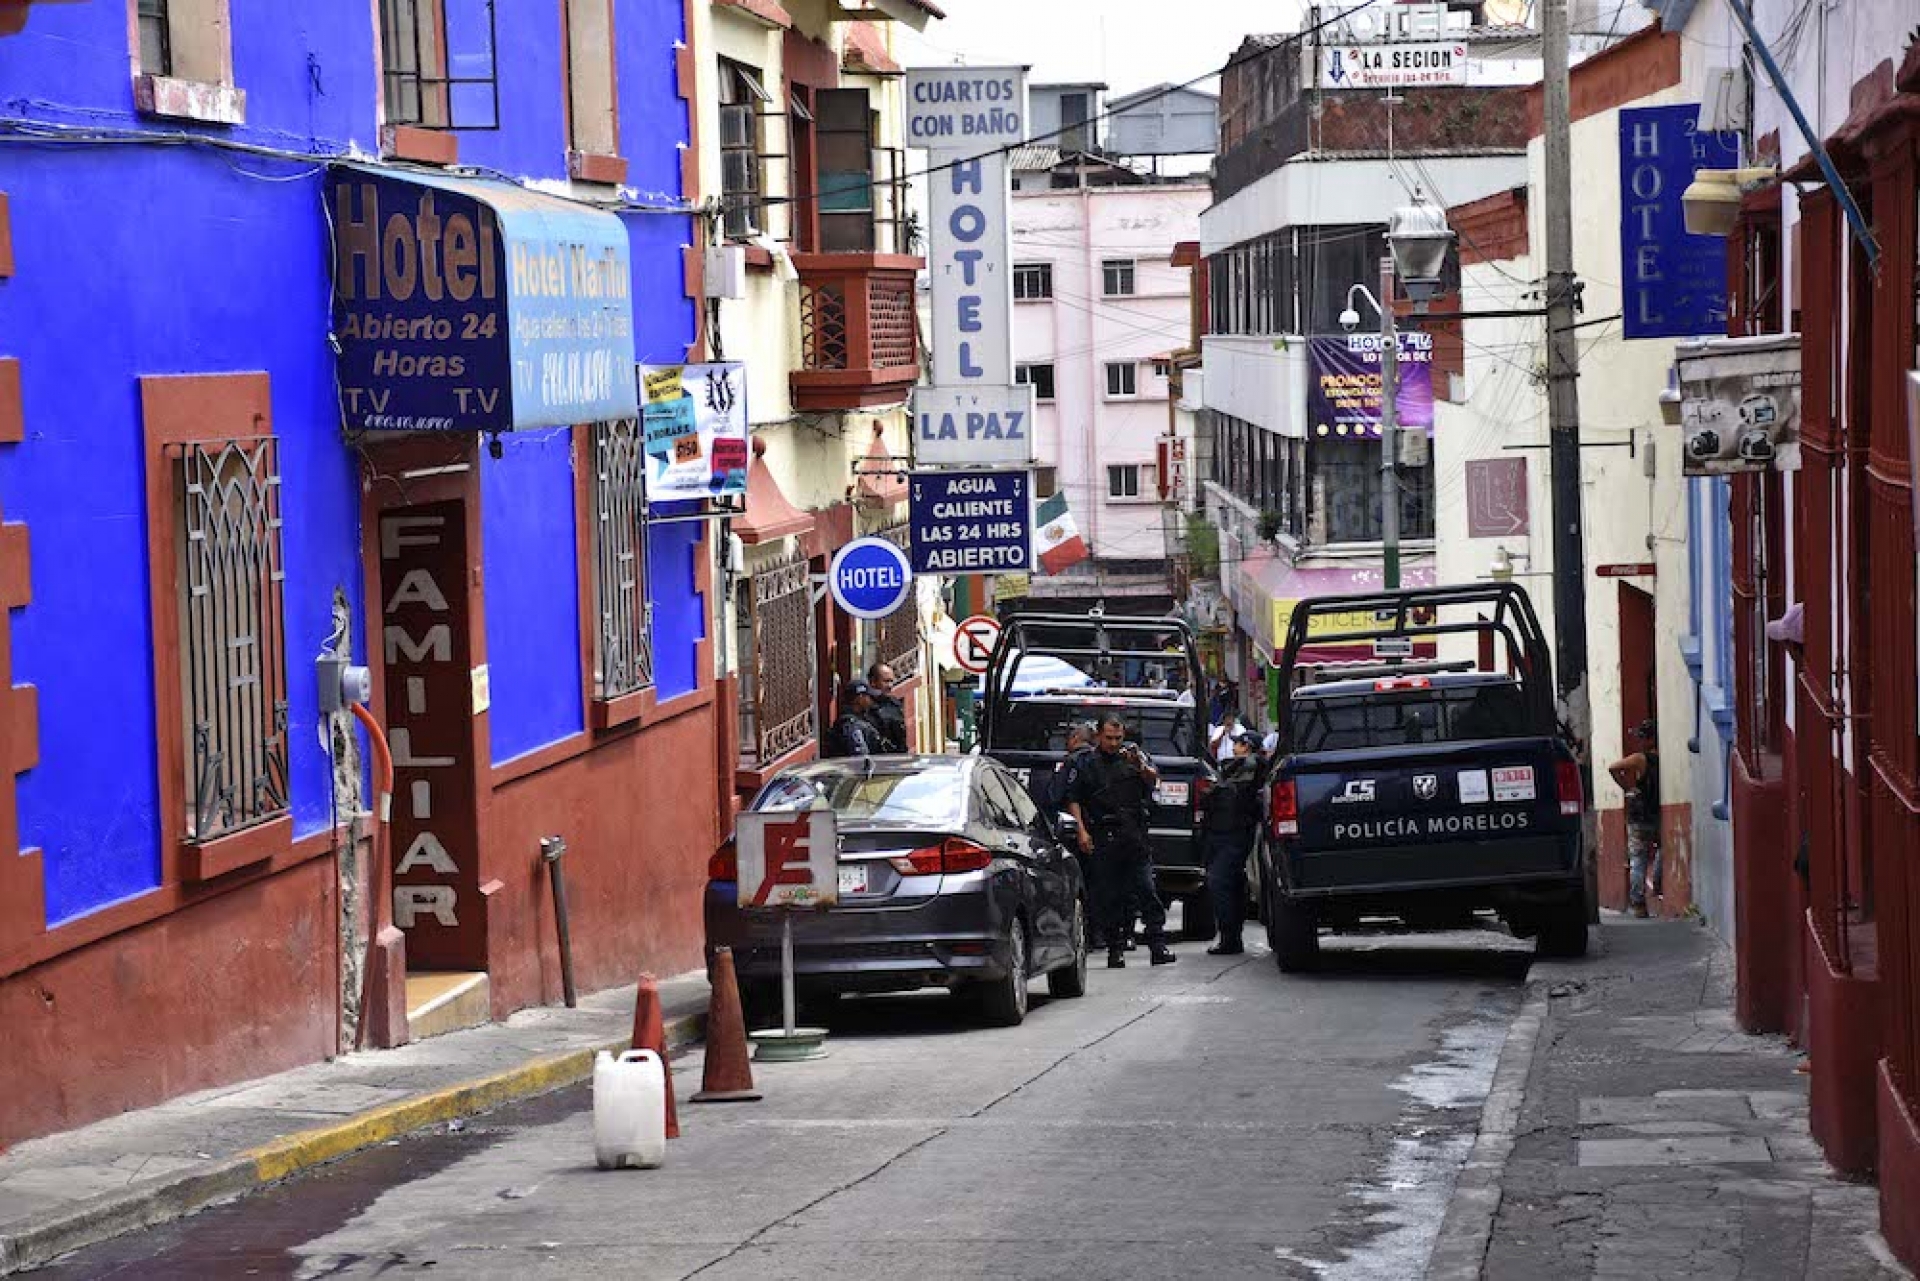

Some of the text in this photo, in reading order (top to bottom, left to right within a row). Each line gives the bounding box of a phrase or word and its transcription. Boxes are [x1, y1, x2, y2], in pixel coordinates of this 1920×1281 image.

[1363, 51, 1450, 68] LA SECION
[914, 80, 1013, 102] CUARTOS
[912, 108, 1019, 136] CON BAÑO
[1632, 122, 1663, 323] HOTEL
[336, 184, 496, 300] Hotel
[512, 243, 566, 297] Hotel
[950, 157, 986, 377] HOTEL
[342, 312, 497, 340] Abierto 24
[373, 350, 465, 377] Horas
[345, 388, 390, 414] T.V
[453, 388, 499, 414] T.V
[921, 413, 1024, 440] LA PAZ
[946, 478, 997, 494] AGUA
[932, 499, 1013, 518] CALIENTE
[921, 522, 1022, 542] LAS 24 HRS
[926, 546, 1024, 569] ABIERTO
[840, 566, 901, 589] HOTEL
[381, 516, 459, 928] FAMILIAR
[1334, 812, 1528, 839] POLICÍA MORELOS
